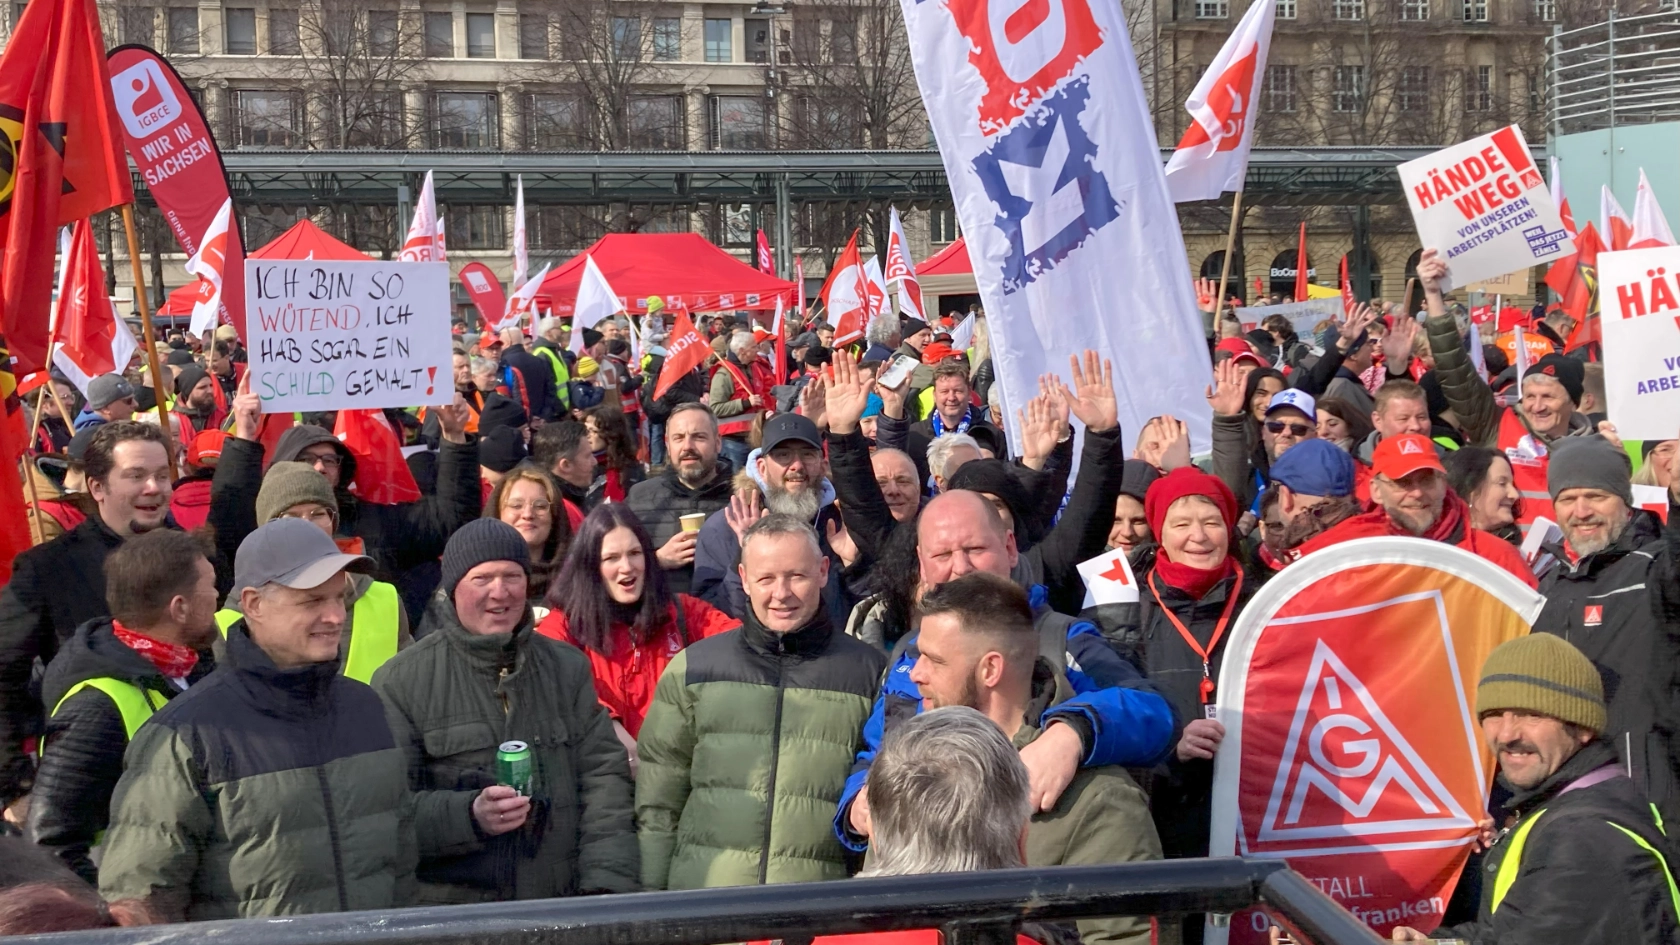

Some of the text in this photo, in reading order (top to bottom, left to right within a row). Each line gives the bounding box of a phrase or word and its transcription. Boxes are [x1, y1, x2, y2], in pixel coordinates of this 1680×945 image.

[138, 105, 171, 129] IGBCE
[141, 122, 193, 162] WIR IN
[145, 137, 211, 186] SACHSEN
[1414, 146, 1505, 209] HÄNDE
[167, 210, 187, 238] DEINE
[1457, 197, 1530, 238] VON UNSEREN
[1446, 207, 1538, 259] ARBEITSPLÄTZEN!
[256, 265, 404, 300] ICH BIN SO
[1271, 268, 1316, 277] BoConpt
[1616, 267, 1680, 319] HÄ
[376, 304, 413, 325] ICH
[261, 336, 410, 363] HAB SOGAR EIN
[1508, 341, 1546, 350] ORAM
[260, 371, 335, 400] SCHILD
[1307, 876, 1374, 899] TALL
